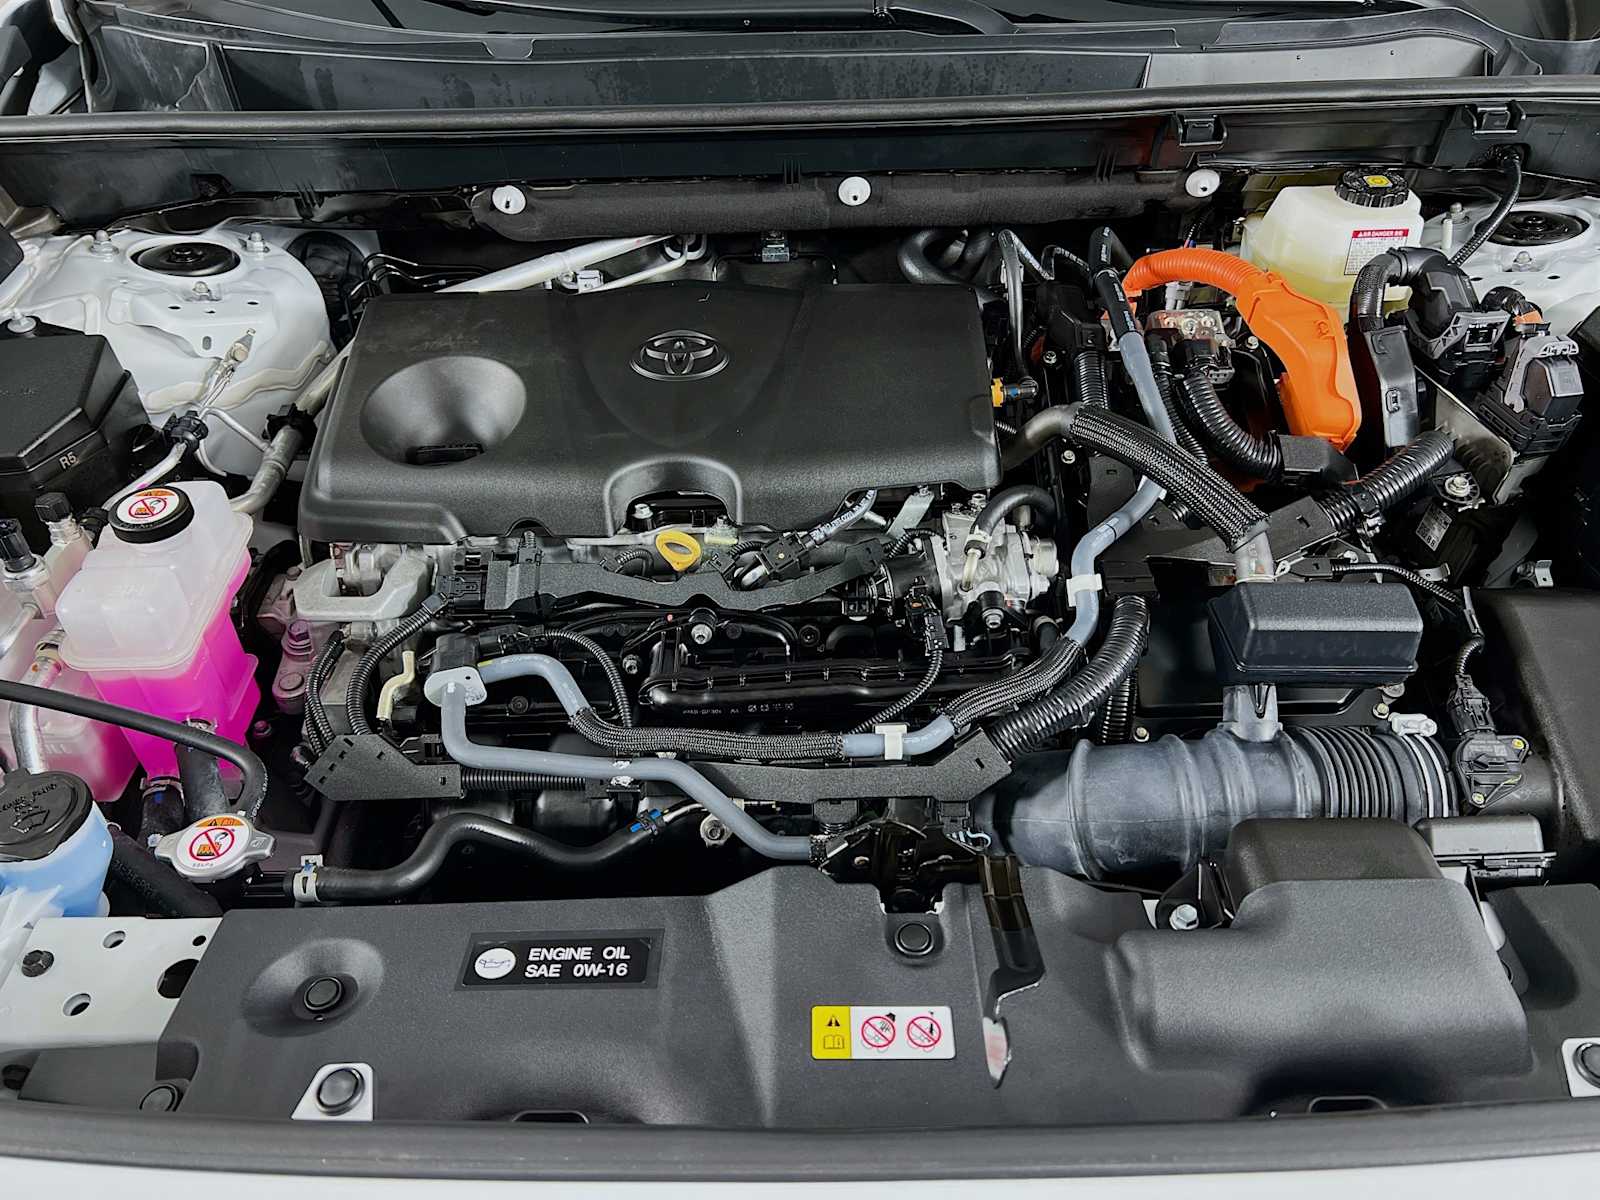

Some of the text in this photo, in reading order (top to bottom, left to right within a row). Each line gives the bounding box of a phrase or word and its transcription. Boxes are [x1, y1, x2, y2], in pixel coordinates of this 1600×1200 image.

[528, 946, 631, 961] ENGINE OIL
[524, 963, 628, 977] SAE 0W-16
